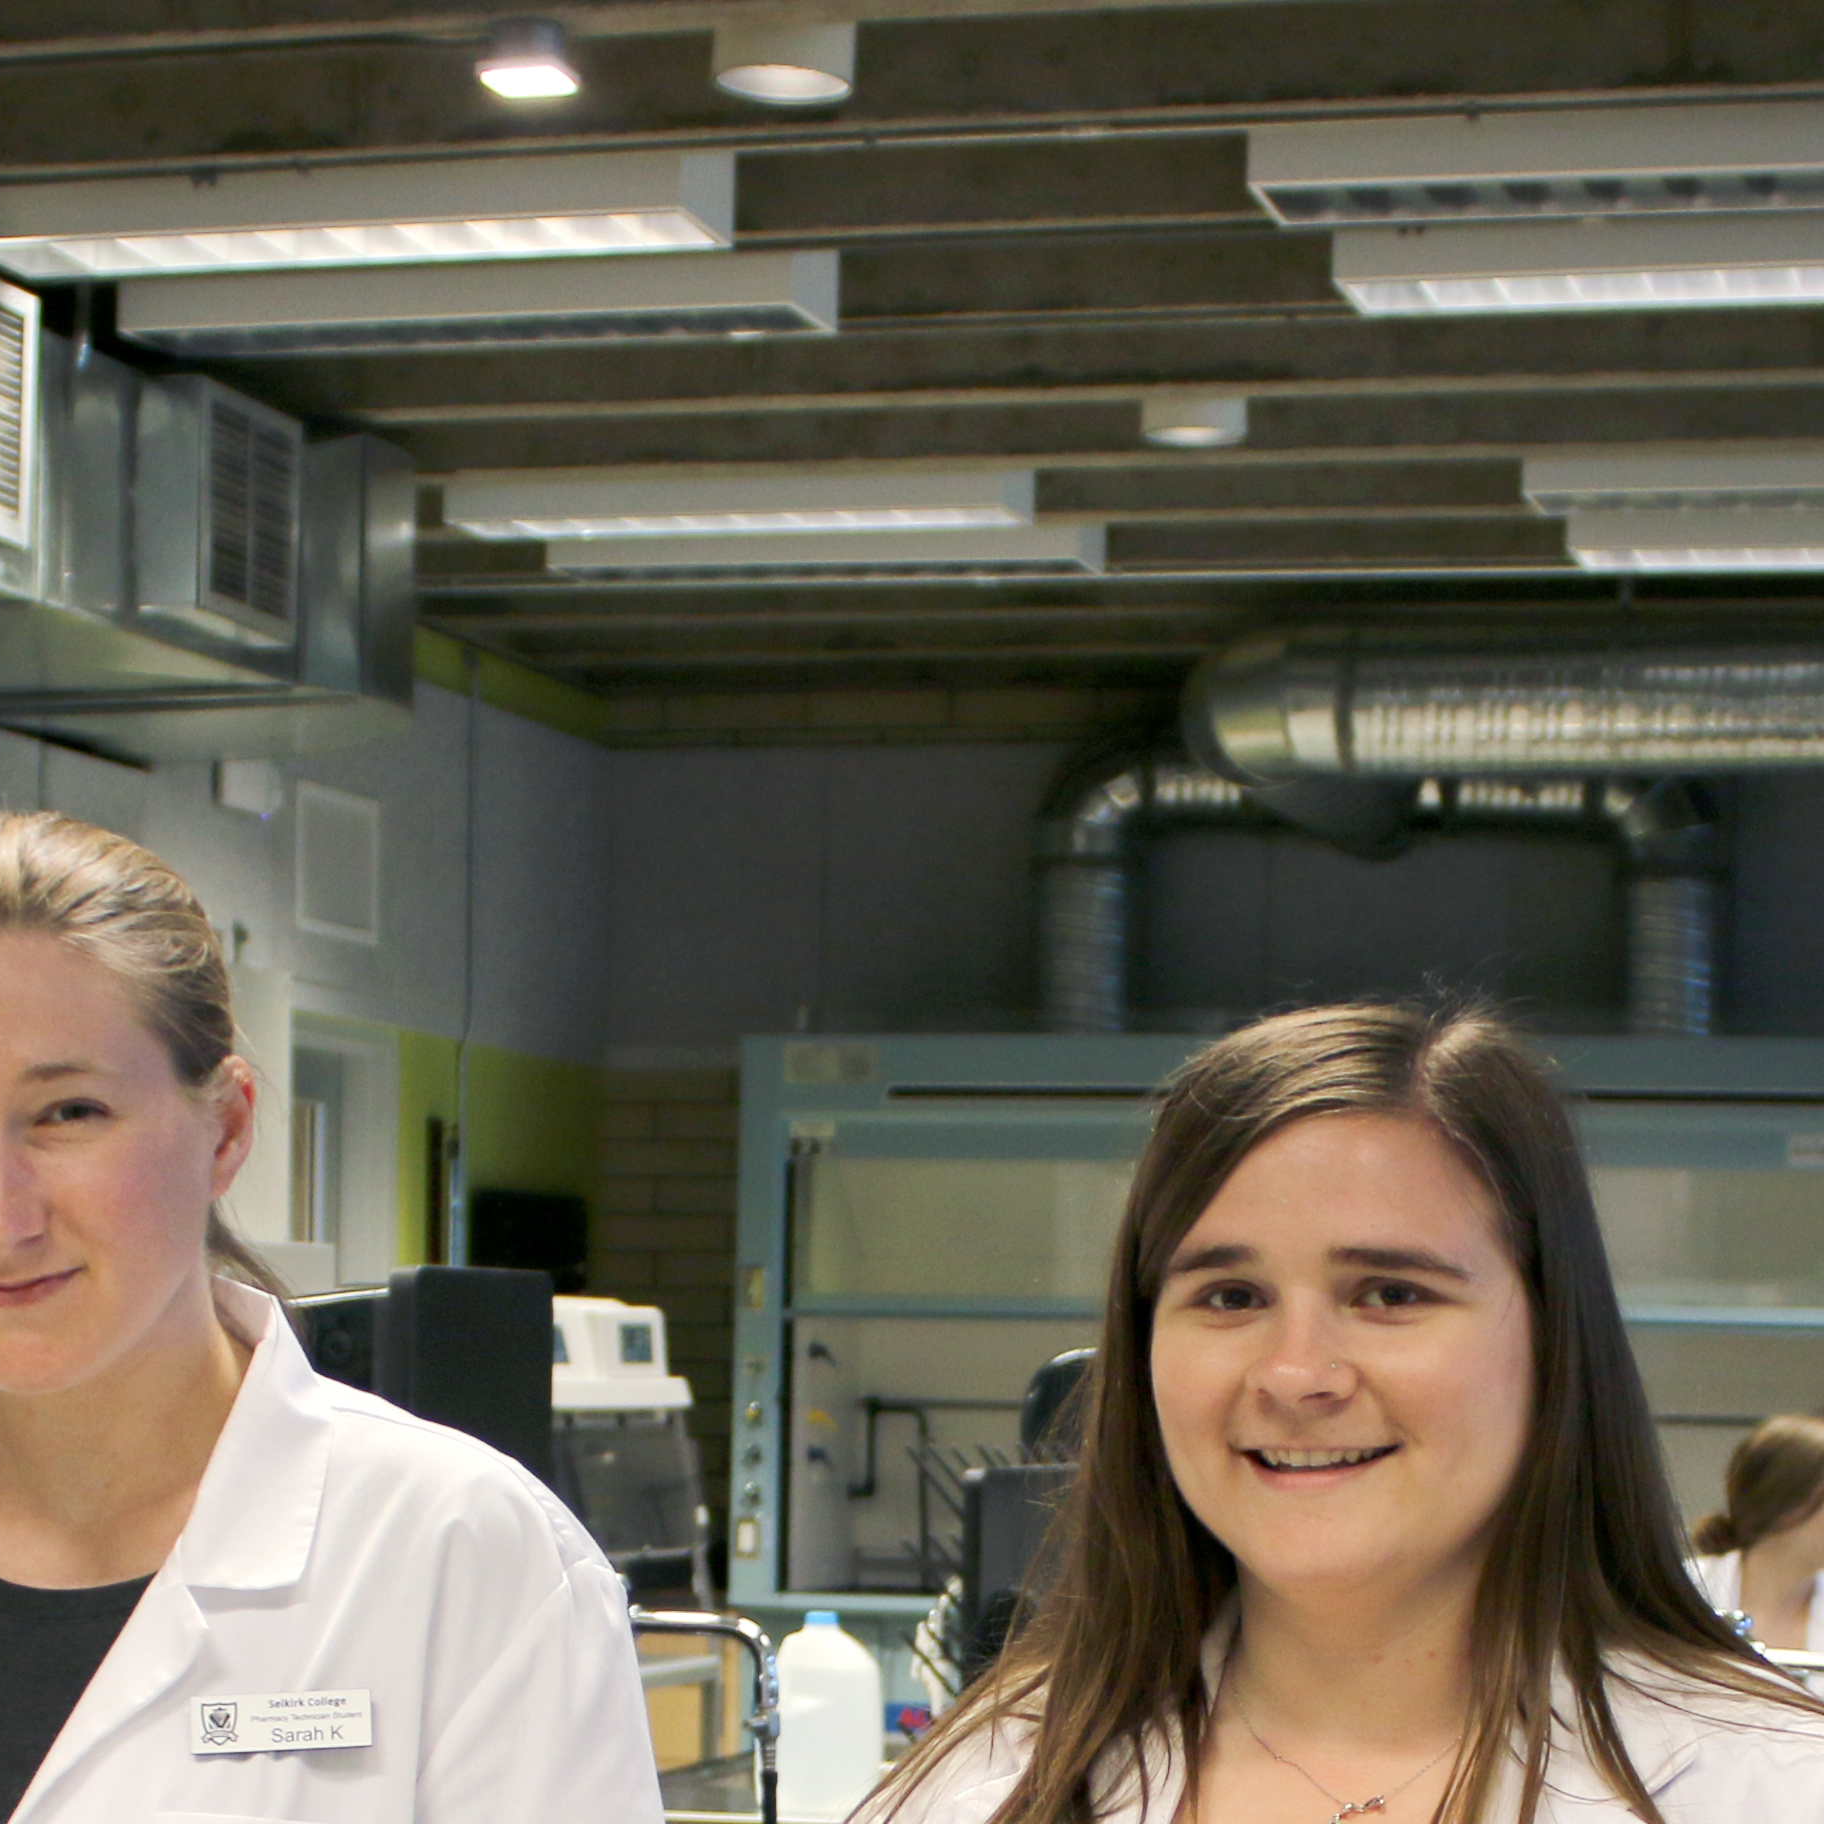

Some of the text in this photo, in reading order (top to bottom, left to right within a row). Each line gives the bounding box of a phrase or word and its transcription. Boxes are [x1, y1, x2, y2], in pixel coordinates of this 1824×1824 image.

[269, 1697, 347, 1709] Selkirk College
[251, 1711, 362, 1723] Pharmacy Technician Student
[271, 1725, 343, 1743] Sarah K
